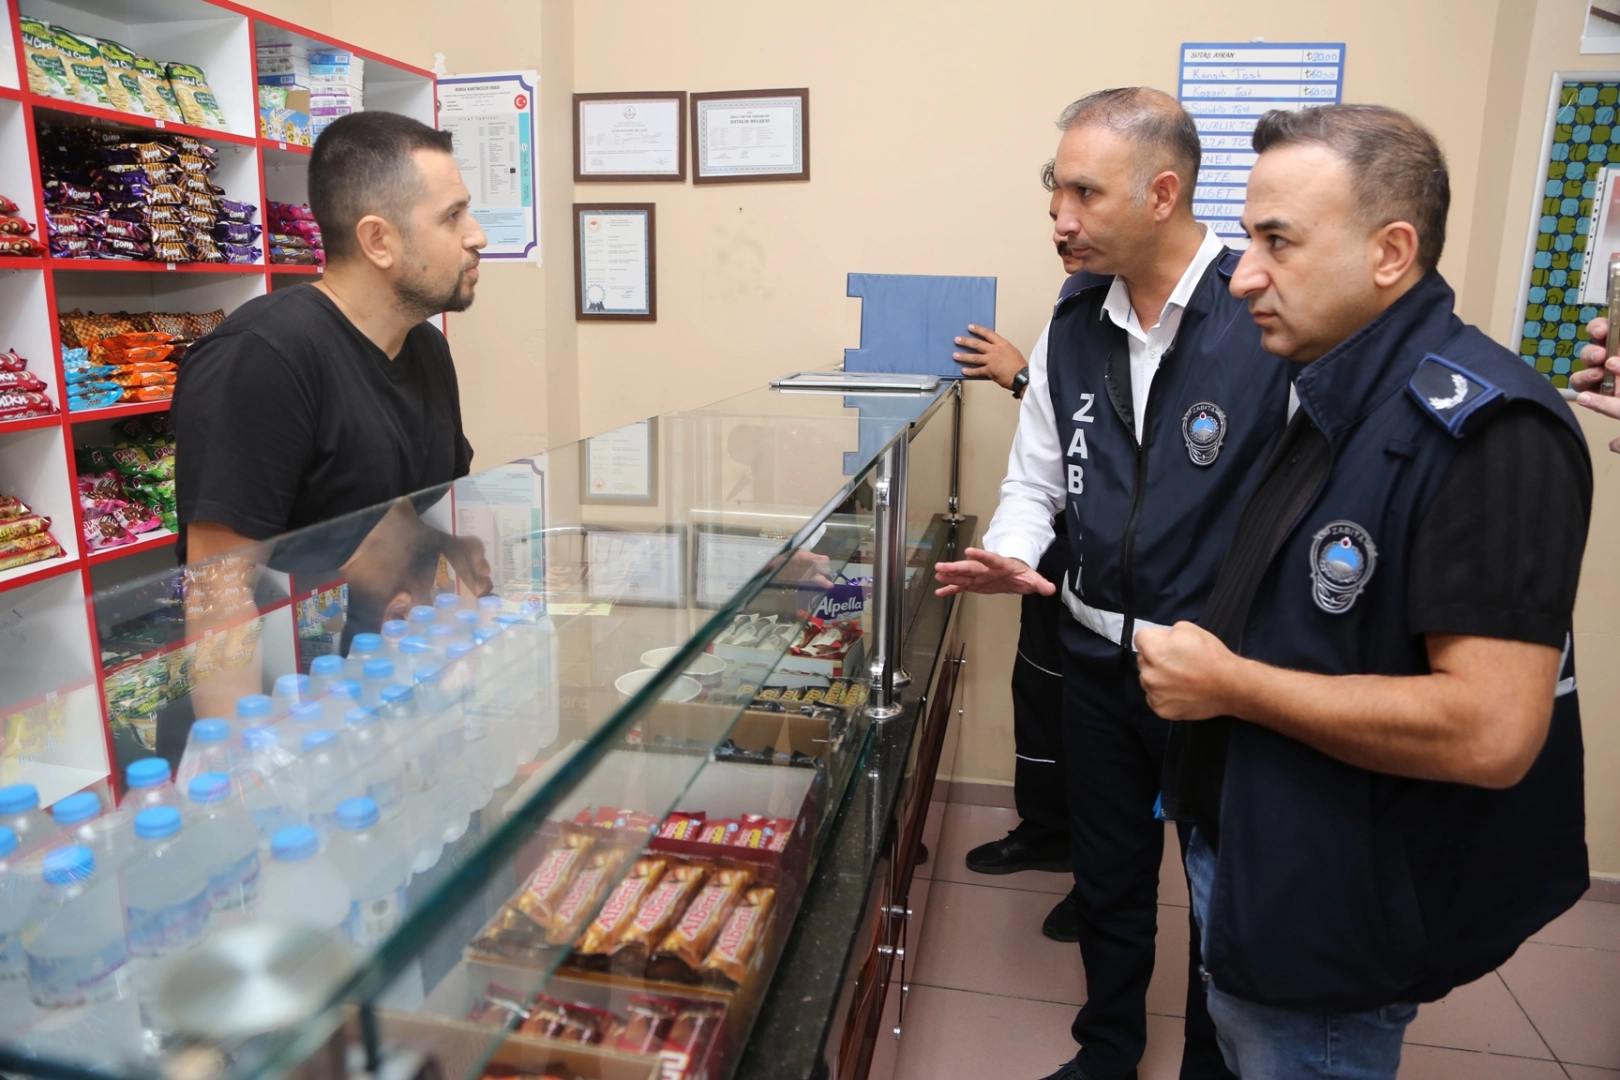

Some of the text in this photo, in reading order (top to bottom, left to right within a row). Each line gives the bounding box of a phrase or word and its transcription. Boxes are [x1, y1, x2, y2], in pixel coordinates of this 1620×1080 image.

[1231, 68, 1262, 80] Tost
[1235, 86, 1252, 97] Tost
[1198, 121, 1236, 132] YVALIK
[73, 190, 91, 199] Gong
[1197, 188, 1237, 200] UGET
[1194, 204, 1232, 216] UMRU
[107, 225, 127, 235] Gong
[113, 240, 134, 249] Gong
[1332, 527, 1366, 544] ZABITA
[812, 596, 862, 618] Alpella
[529, 849, 574, 899] Albeni
[597, 879, 642, 931] Albeni
[637, 883, 680, 930] Albeni
[681, 887, 724, 939] Albeni
[719, 907, 754, 958] Albeni
